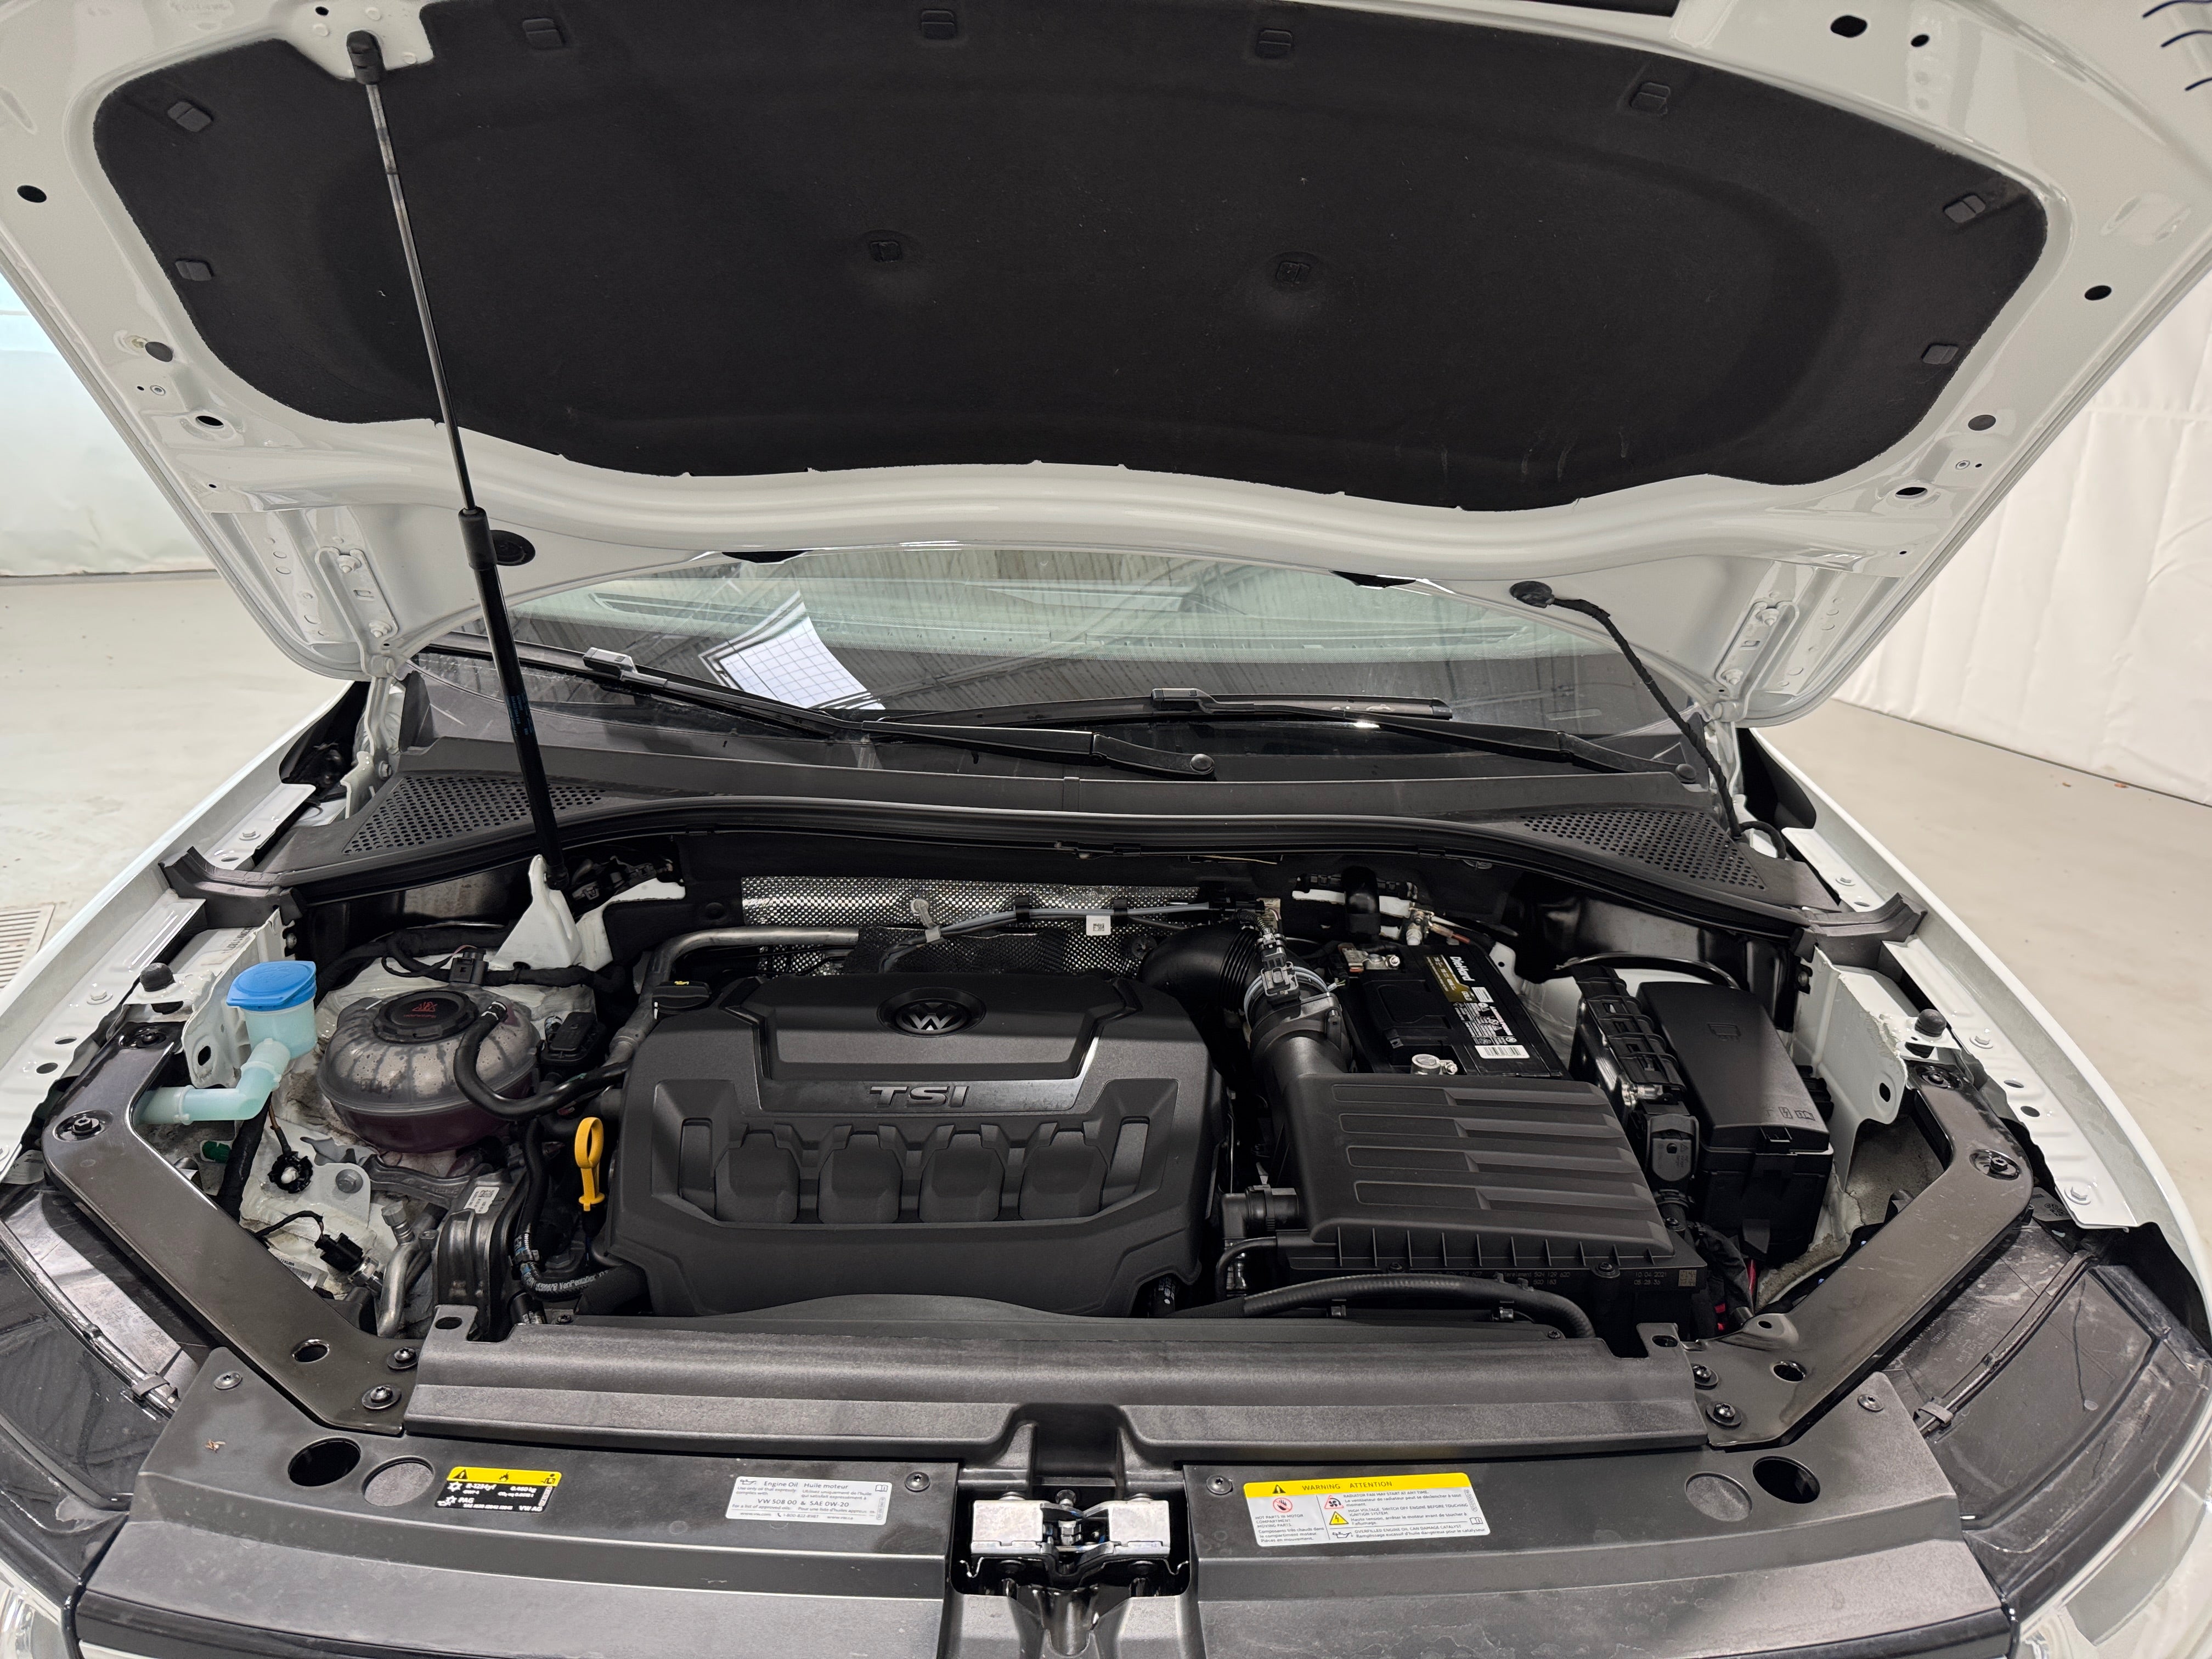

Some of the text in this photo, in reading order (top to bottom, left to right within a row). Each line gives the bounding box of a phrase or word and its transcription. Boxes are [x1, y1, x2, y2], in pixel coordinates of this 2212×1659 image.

[1449, 956, 1475, 981] DieHard
[1462, 991, 1472, 1001] GOLD
[870, 1086, 969, 1108] TSI
